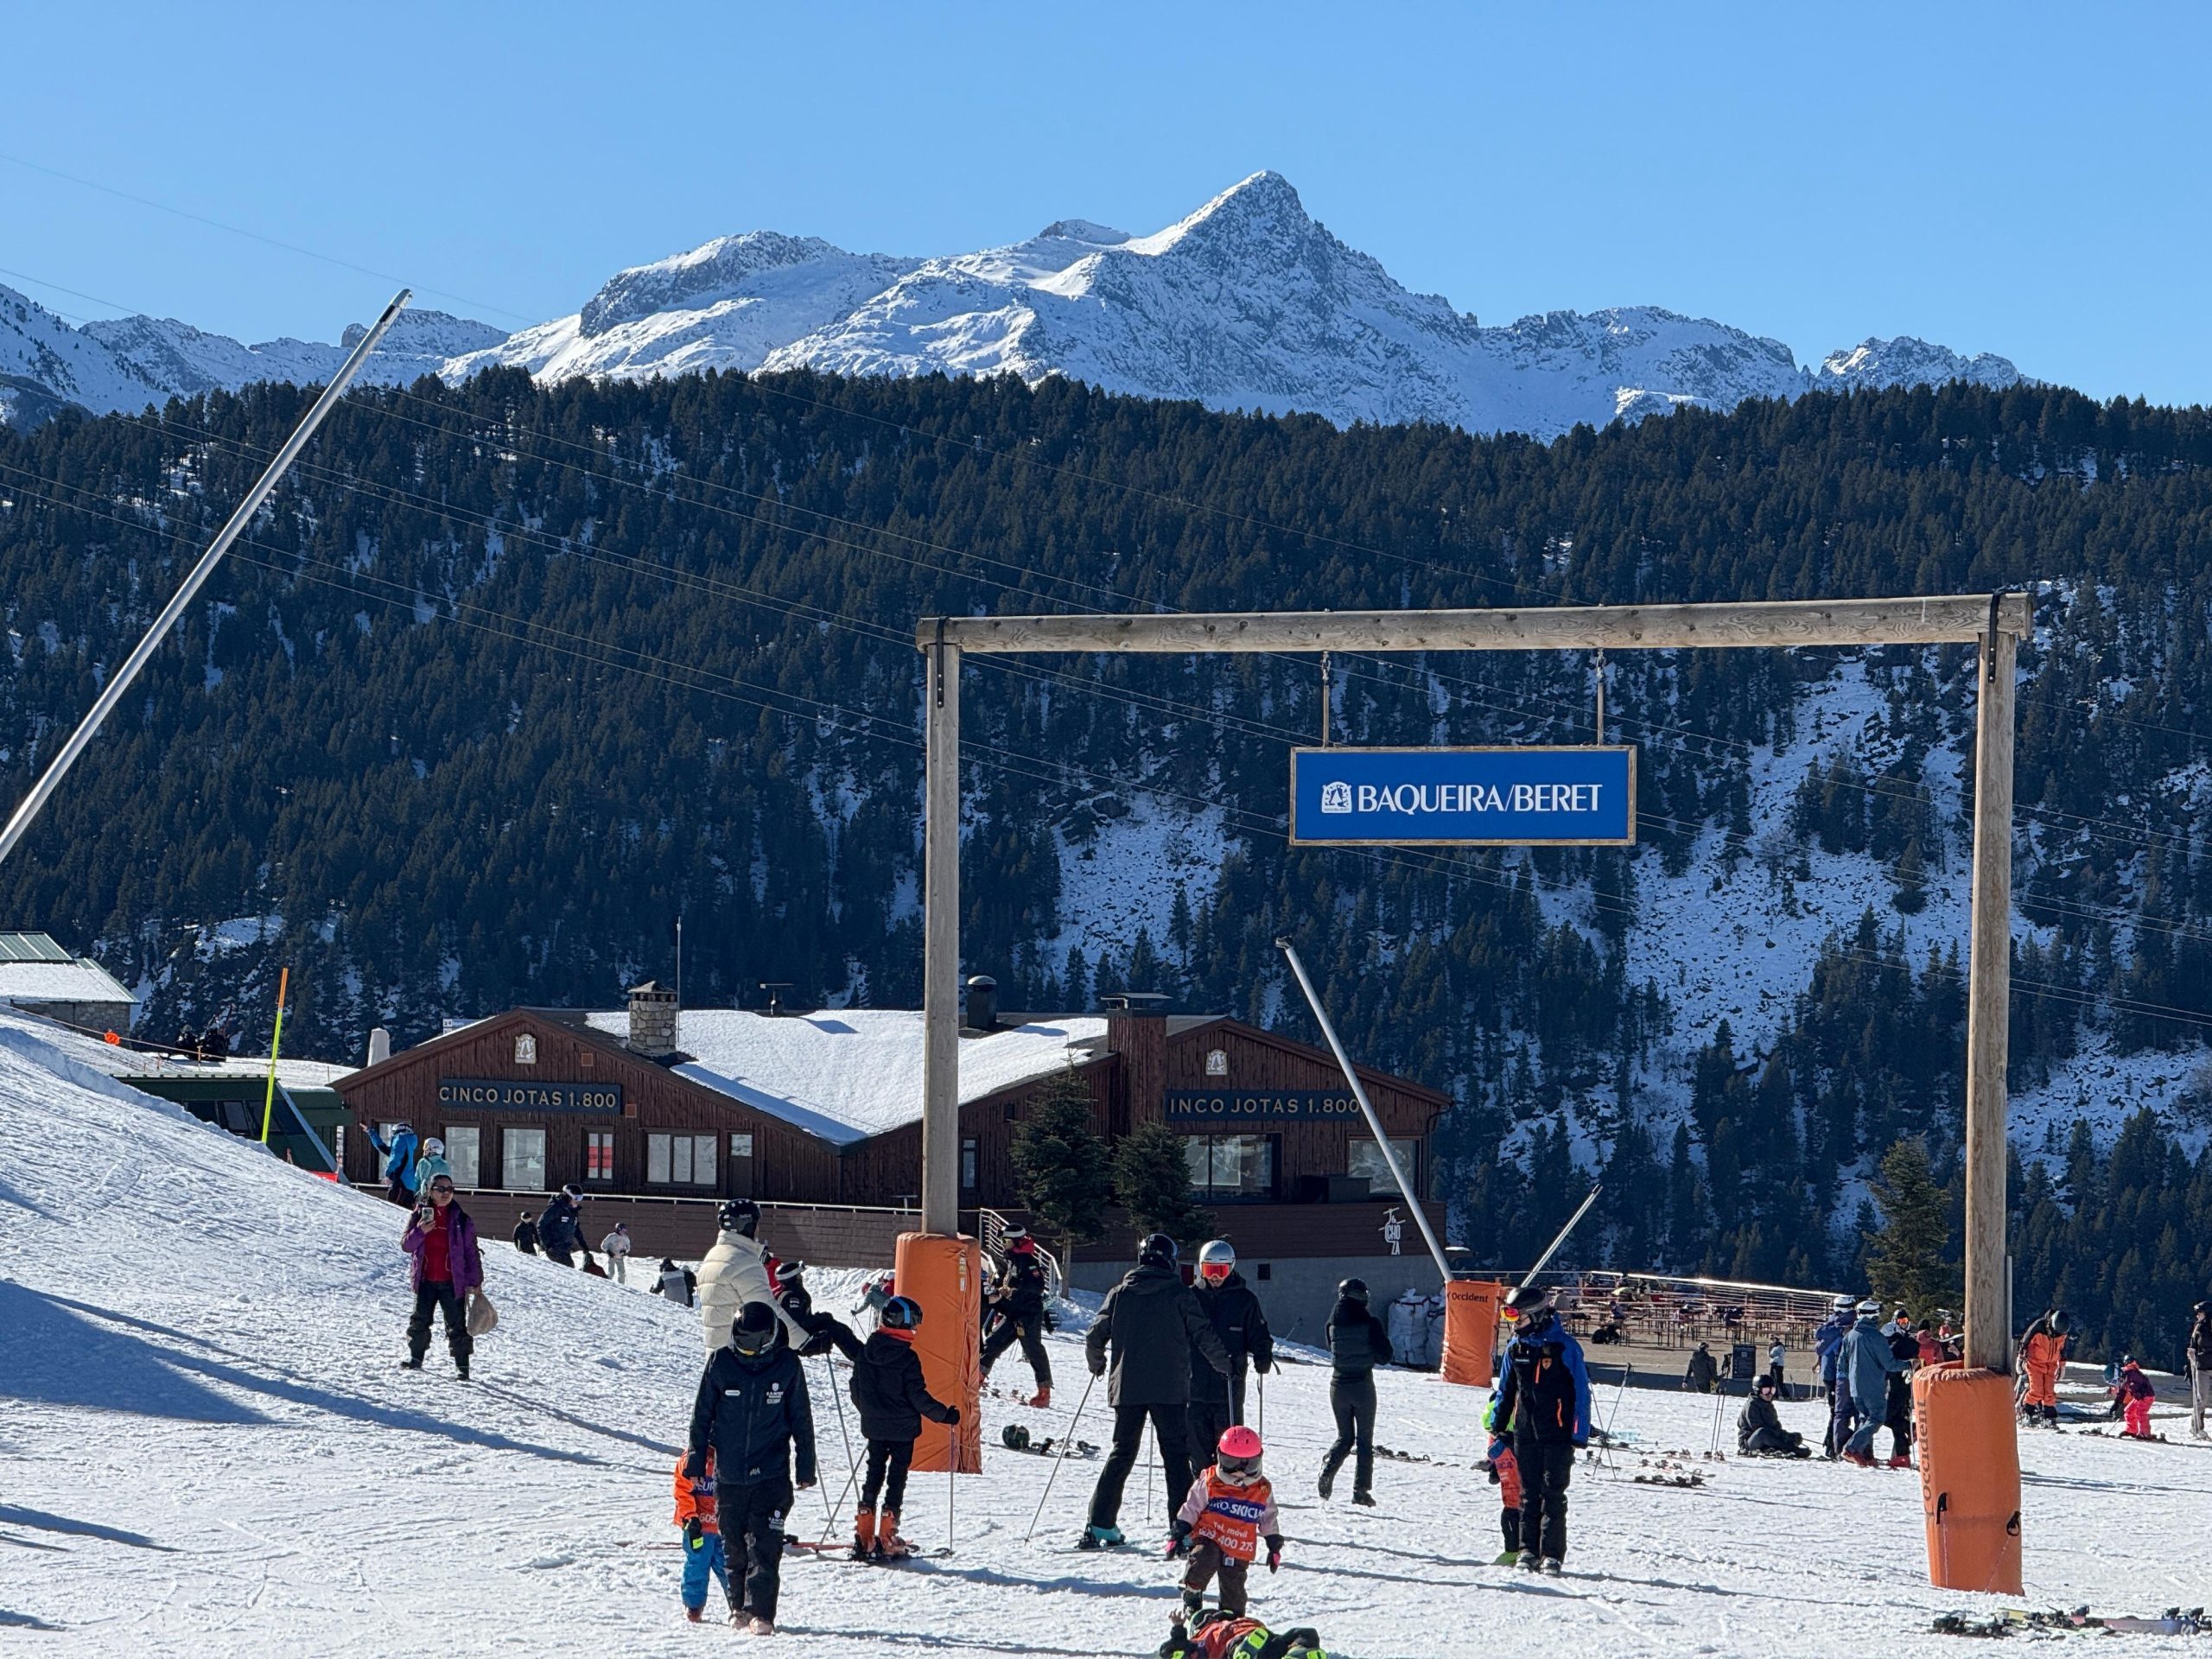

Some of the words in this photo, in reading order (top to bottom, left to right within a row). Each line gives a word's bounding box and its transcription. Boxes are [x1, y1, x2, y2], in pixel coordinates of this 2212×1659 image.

[1358, 784, 1603, 815] BAQUEIRA/BERET
[439, 1087, 499, 1103] CINCO
[503, 1089, 562, 1106] JOTAS
[569, 1091, 616, 1108] 1.800
[1170, 1098, 1224, 1113] INCO
[1230, 1098, 1299, 1113] JOTAS
[1307, 1098, 1359, 1114] 1.800
[1452, 1292, 1489, 1303] Occident
[1917, 1399, 1932, 1502] Occident
[1218, 1535, 1238, 1549] 400
